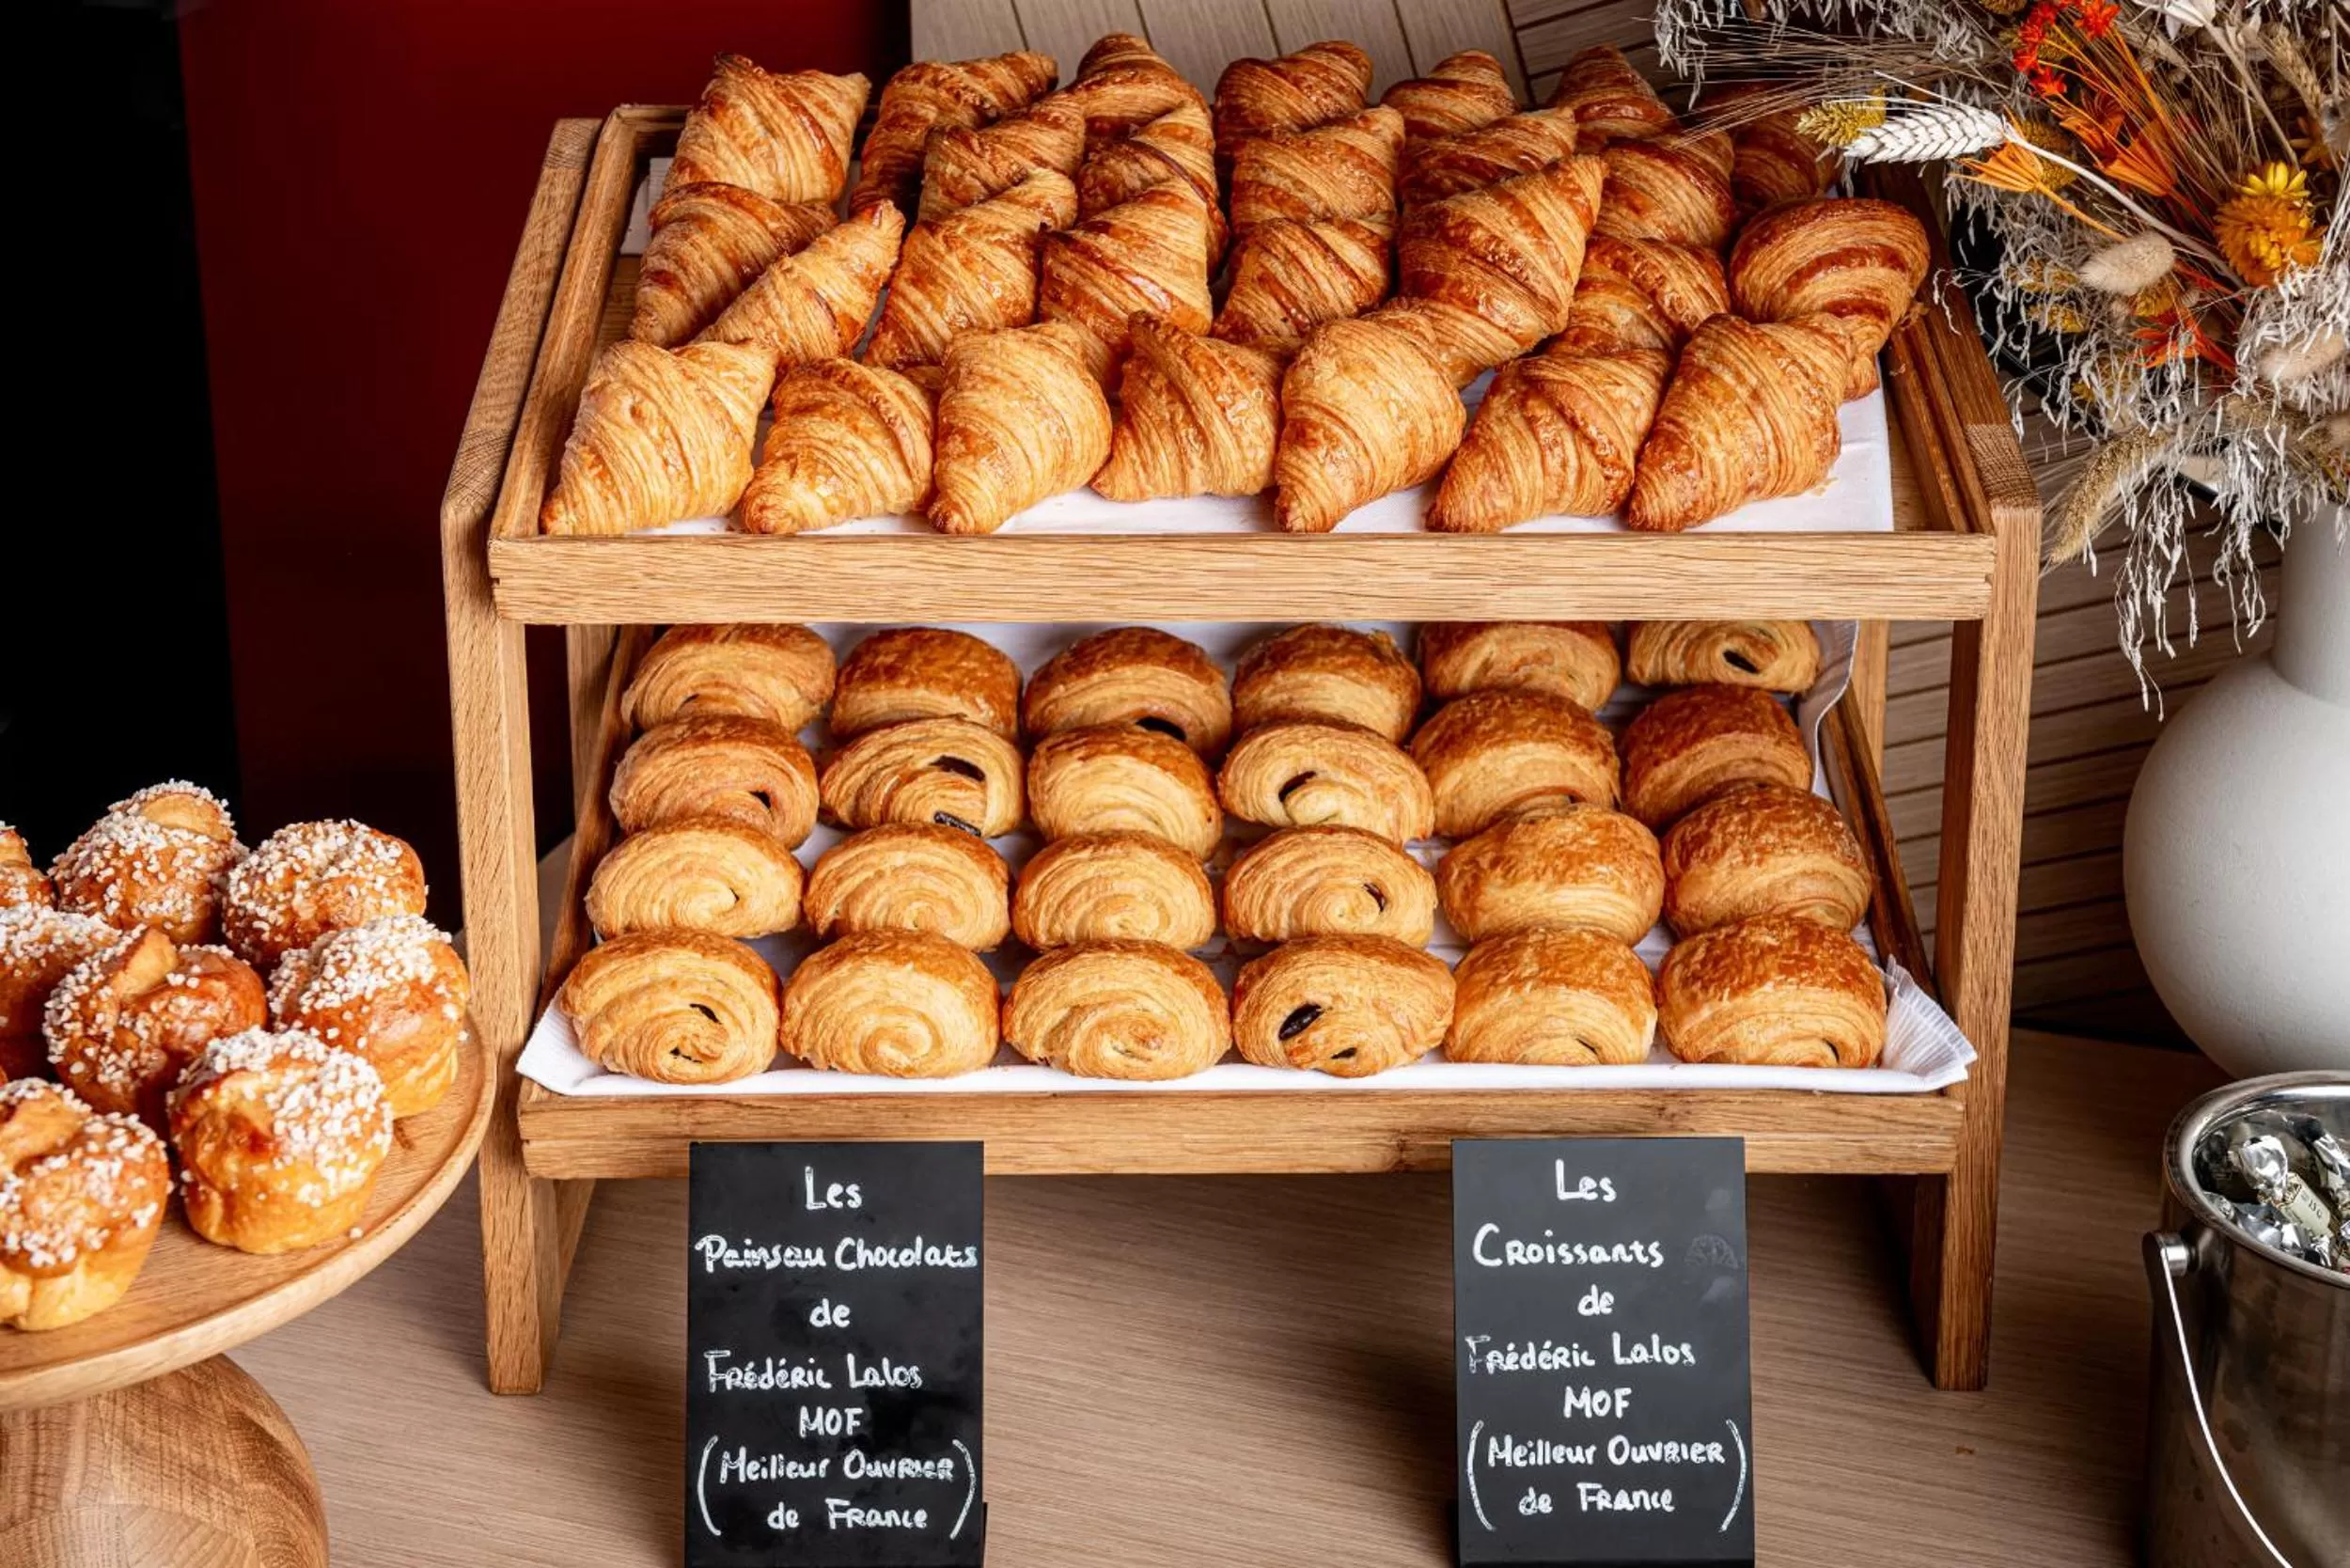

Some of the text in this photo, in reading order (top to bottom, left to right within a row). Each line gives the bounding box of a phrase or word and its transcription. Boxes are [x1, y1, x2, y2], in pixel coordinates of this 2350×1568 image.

[805, 1166, 863, 1211] Les
[1554, 1157, 1618, 1203] Les
[835, 1234, 979, 1271] Chocolats
[1472, 1223, 1665, 1269] Croissants
[808, 1298, 851, 1328] de
[1576, 1283, 1615, 1317] de
[1612, 1331, 1697, 1367] Lalos
[846, 1353, 923, 1389] Lalos
[1562, 1386, 1633, 1419] MOF
[799, 1405, 864, 1438] MOF
[767, 1501, 800, 1530] de
[1518, 1486, 1554, 1516] de
